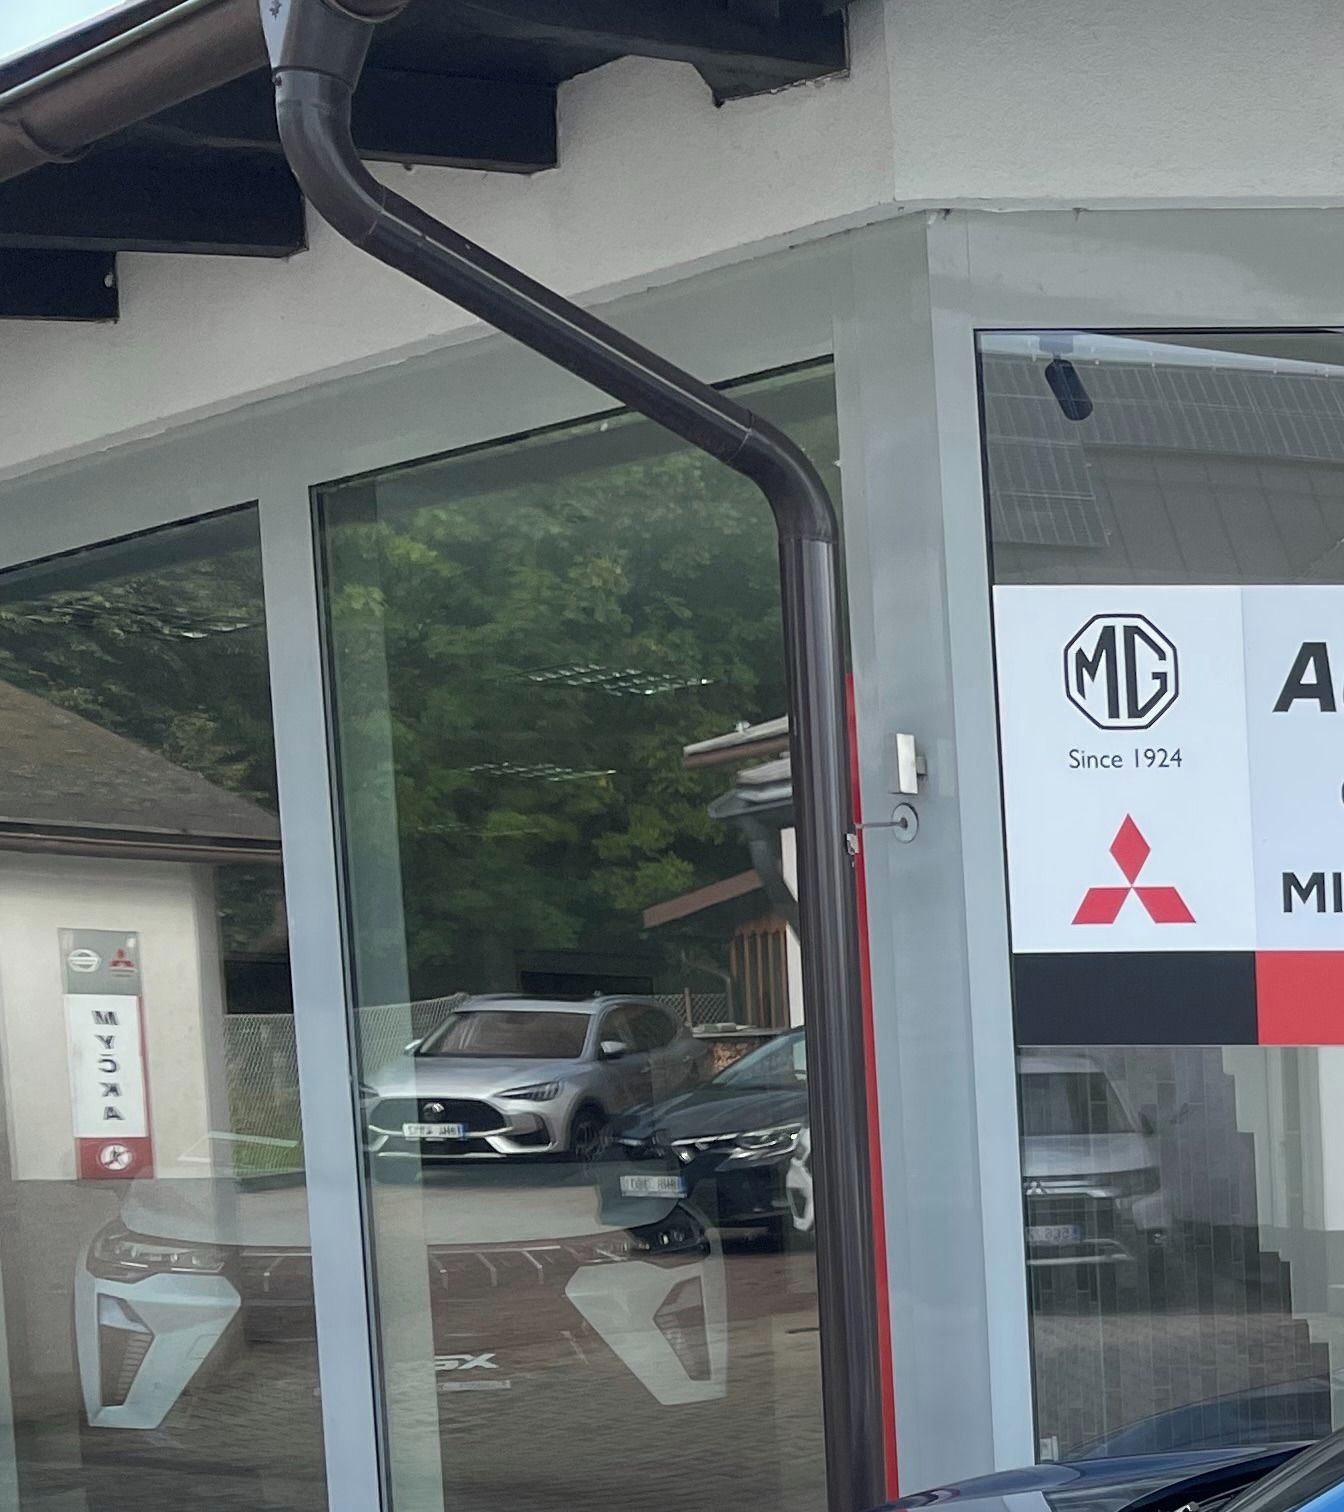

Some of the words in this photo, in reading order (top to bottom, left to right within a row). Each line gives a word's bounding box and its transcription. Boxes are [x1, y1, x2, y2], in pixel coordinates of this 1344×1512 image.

[1072, 621, 1172, 723] MG
[1068, 747, 1124, 769] Since
[1132, 747, 1183, 769] 1924
